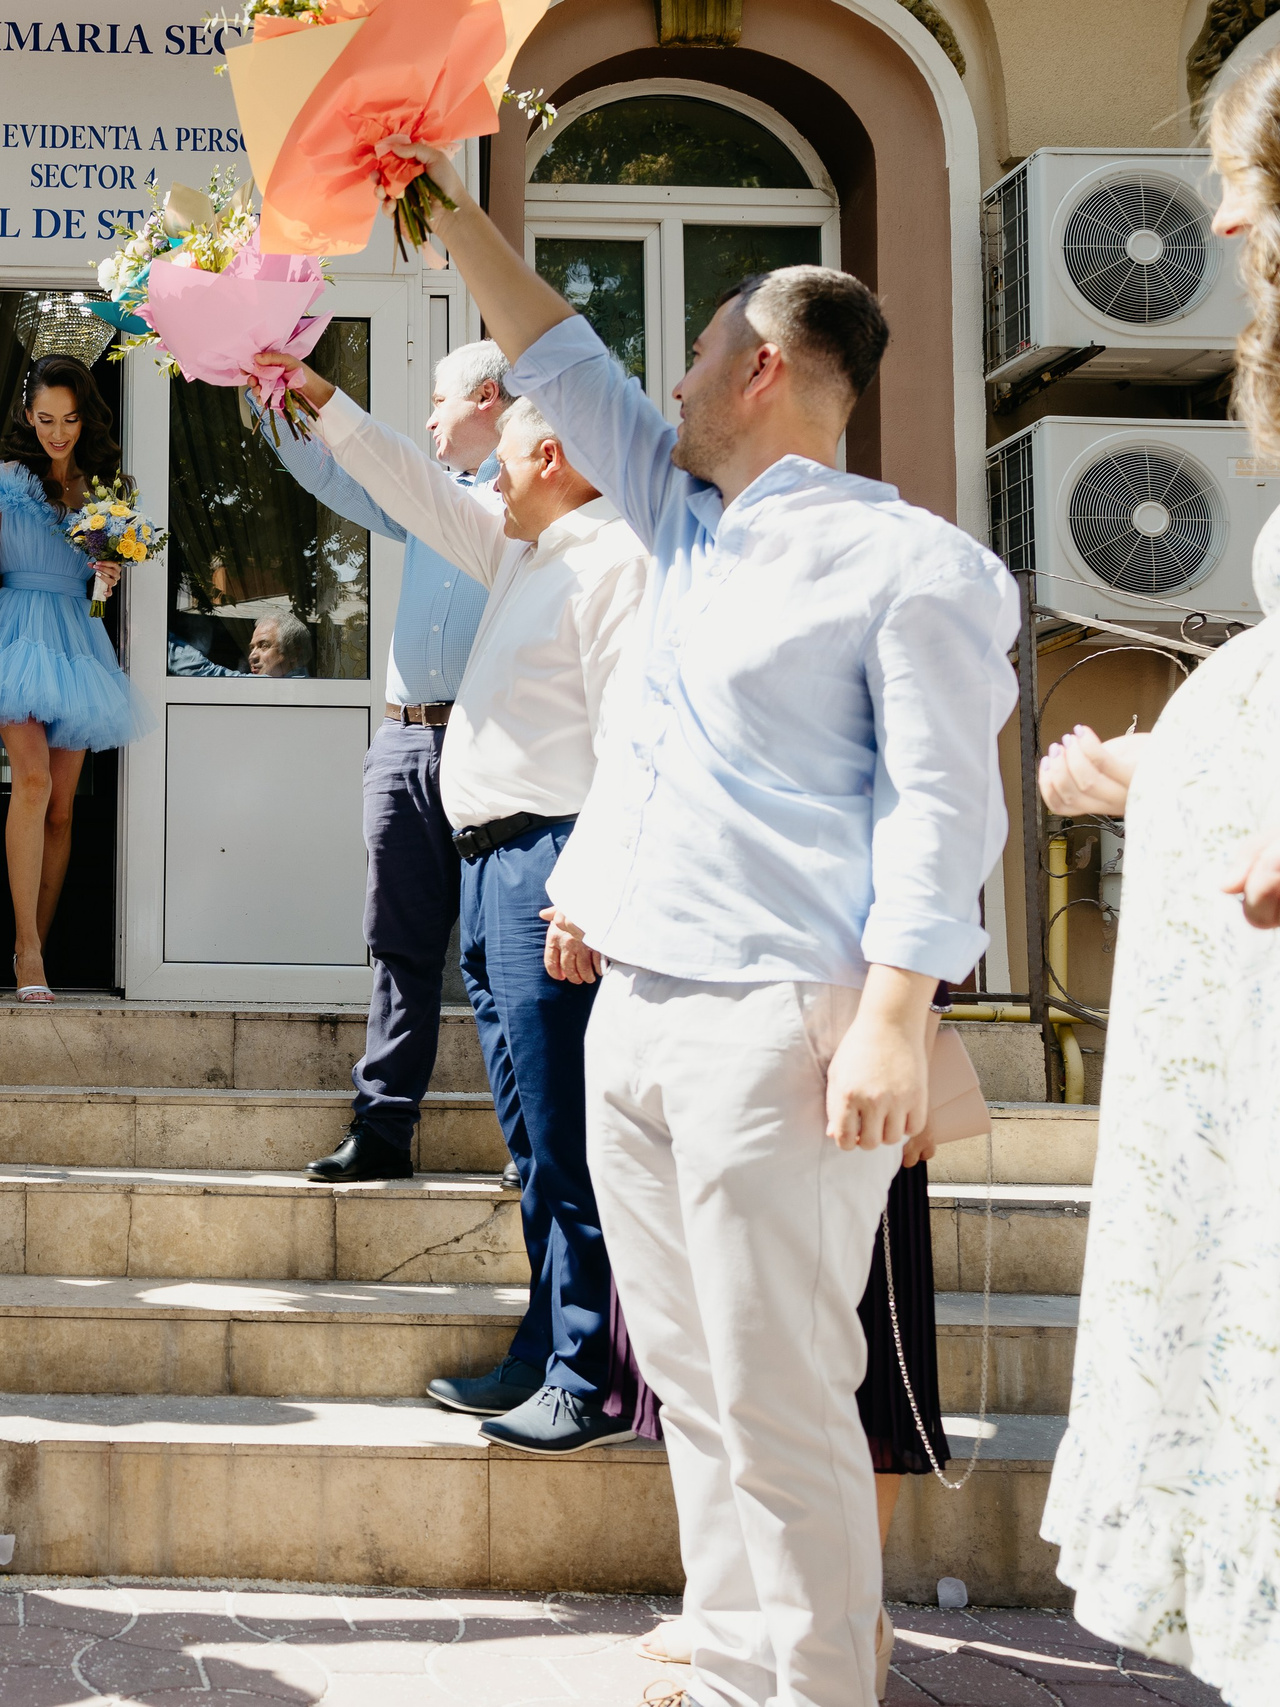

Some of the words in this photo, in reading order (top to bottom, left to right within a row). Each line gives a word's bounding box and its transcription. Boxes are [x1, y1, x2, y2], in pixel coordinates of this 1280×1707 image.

[164, 24, 254, 56] SEC
[2, 123, 142, 151] EVIDENTA
[150, 126, 168, 151] A
[30, 163, 137, 190] SECTOR
[31, 208, 87, 240] DE
